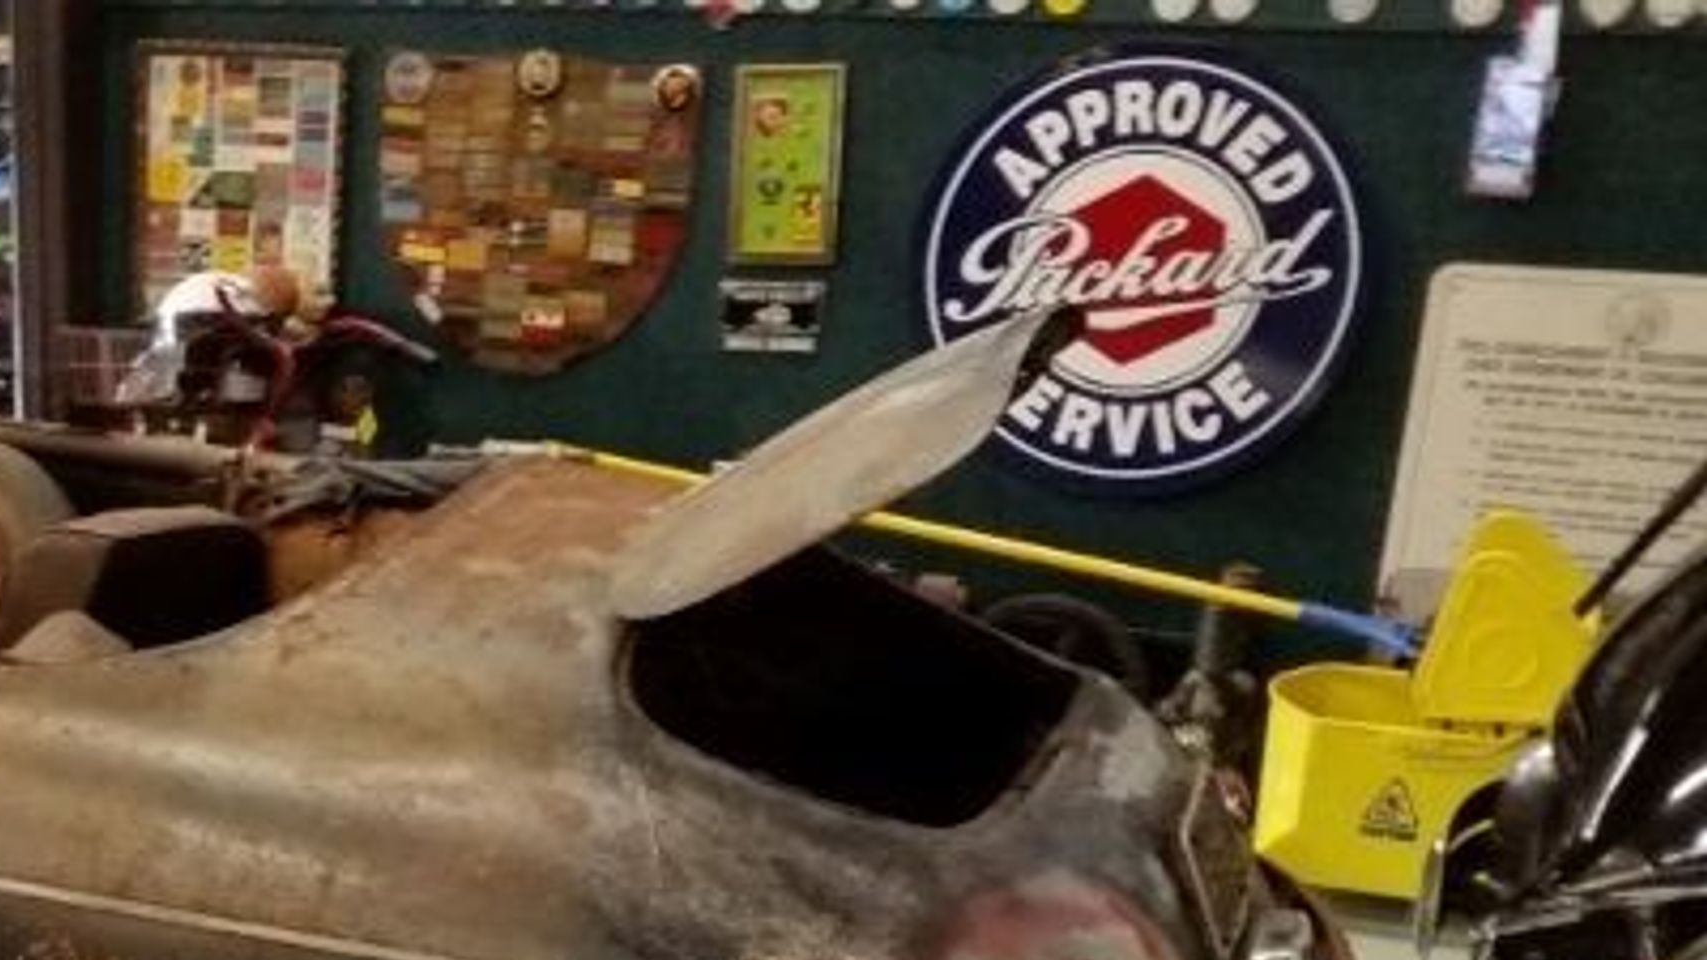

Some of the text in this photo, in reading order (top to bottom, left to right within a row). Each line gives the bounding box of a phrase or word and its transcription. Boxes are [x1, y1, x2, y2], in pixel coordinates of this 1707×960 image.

[994, 80, 1314, 204] APPROVED
[944, 208, 1334, 332] Packard
[1007, 361, 1272, 457] ERVICE
